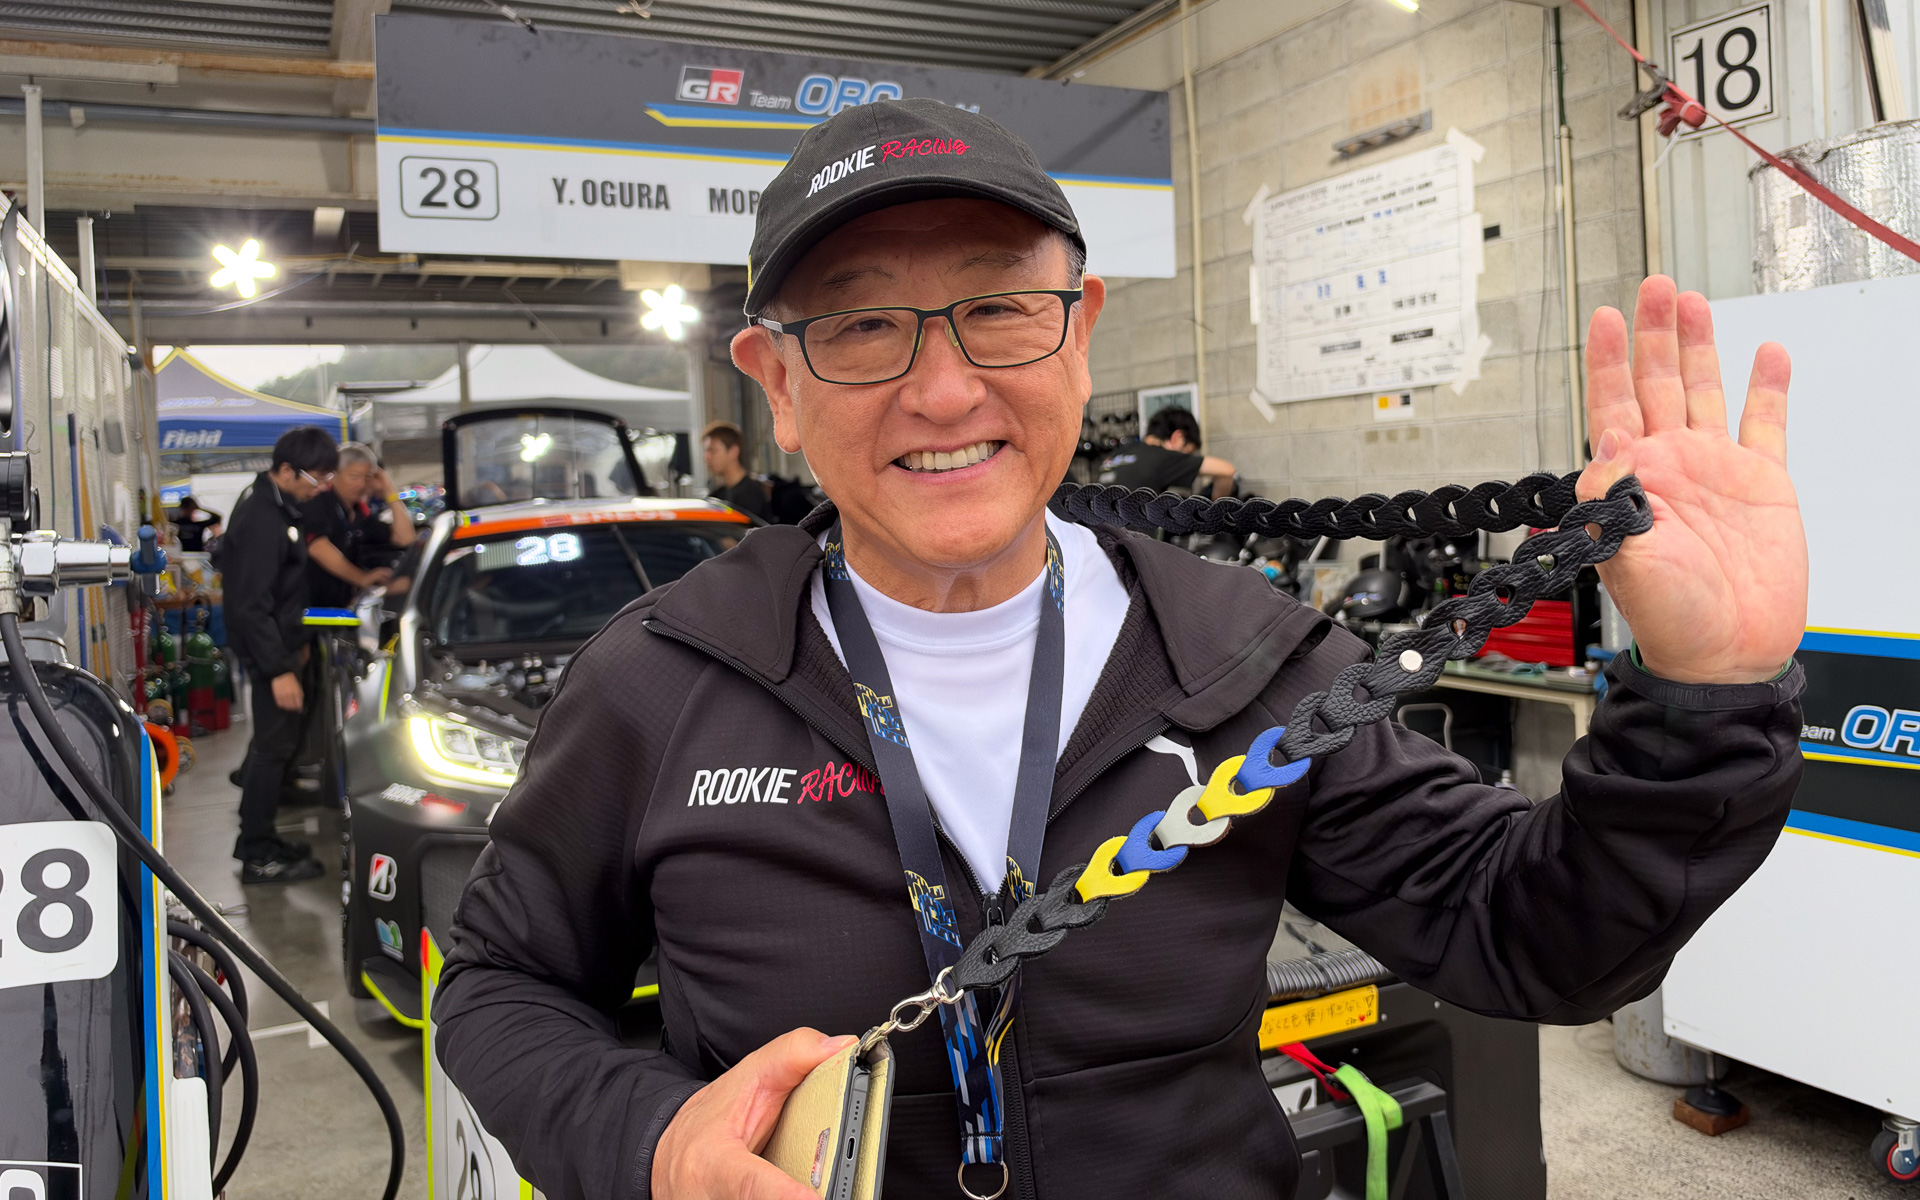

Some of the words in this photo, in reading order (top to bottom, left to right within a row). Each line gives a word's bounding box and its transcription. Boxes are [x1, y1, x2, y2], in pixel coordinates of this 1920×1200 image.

[1682, 26, 1761, 111] 18
[682, 79, 738, 104] GR
[749, 90, 792, 110] Team
[419, 166, 481, 211] 28
[805, 144, 876, 198] ROOKIE
[880, 137, 971, 163] RACING
[552, 177, 576, 205] Y.
[581, 179, 672, 210] OGURA
[162, 428, 222, 449] Field
[515, 533, 582, 566] 28
[1800, 724, 1836, 742] eam
[1841, 704, 1920, 757] OR
[687, 767, 798, 807] ROOKIE
[797, 761, 886, 804] RACIN
[0, 847, 94, 954] 8
